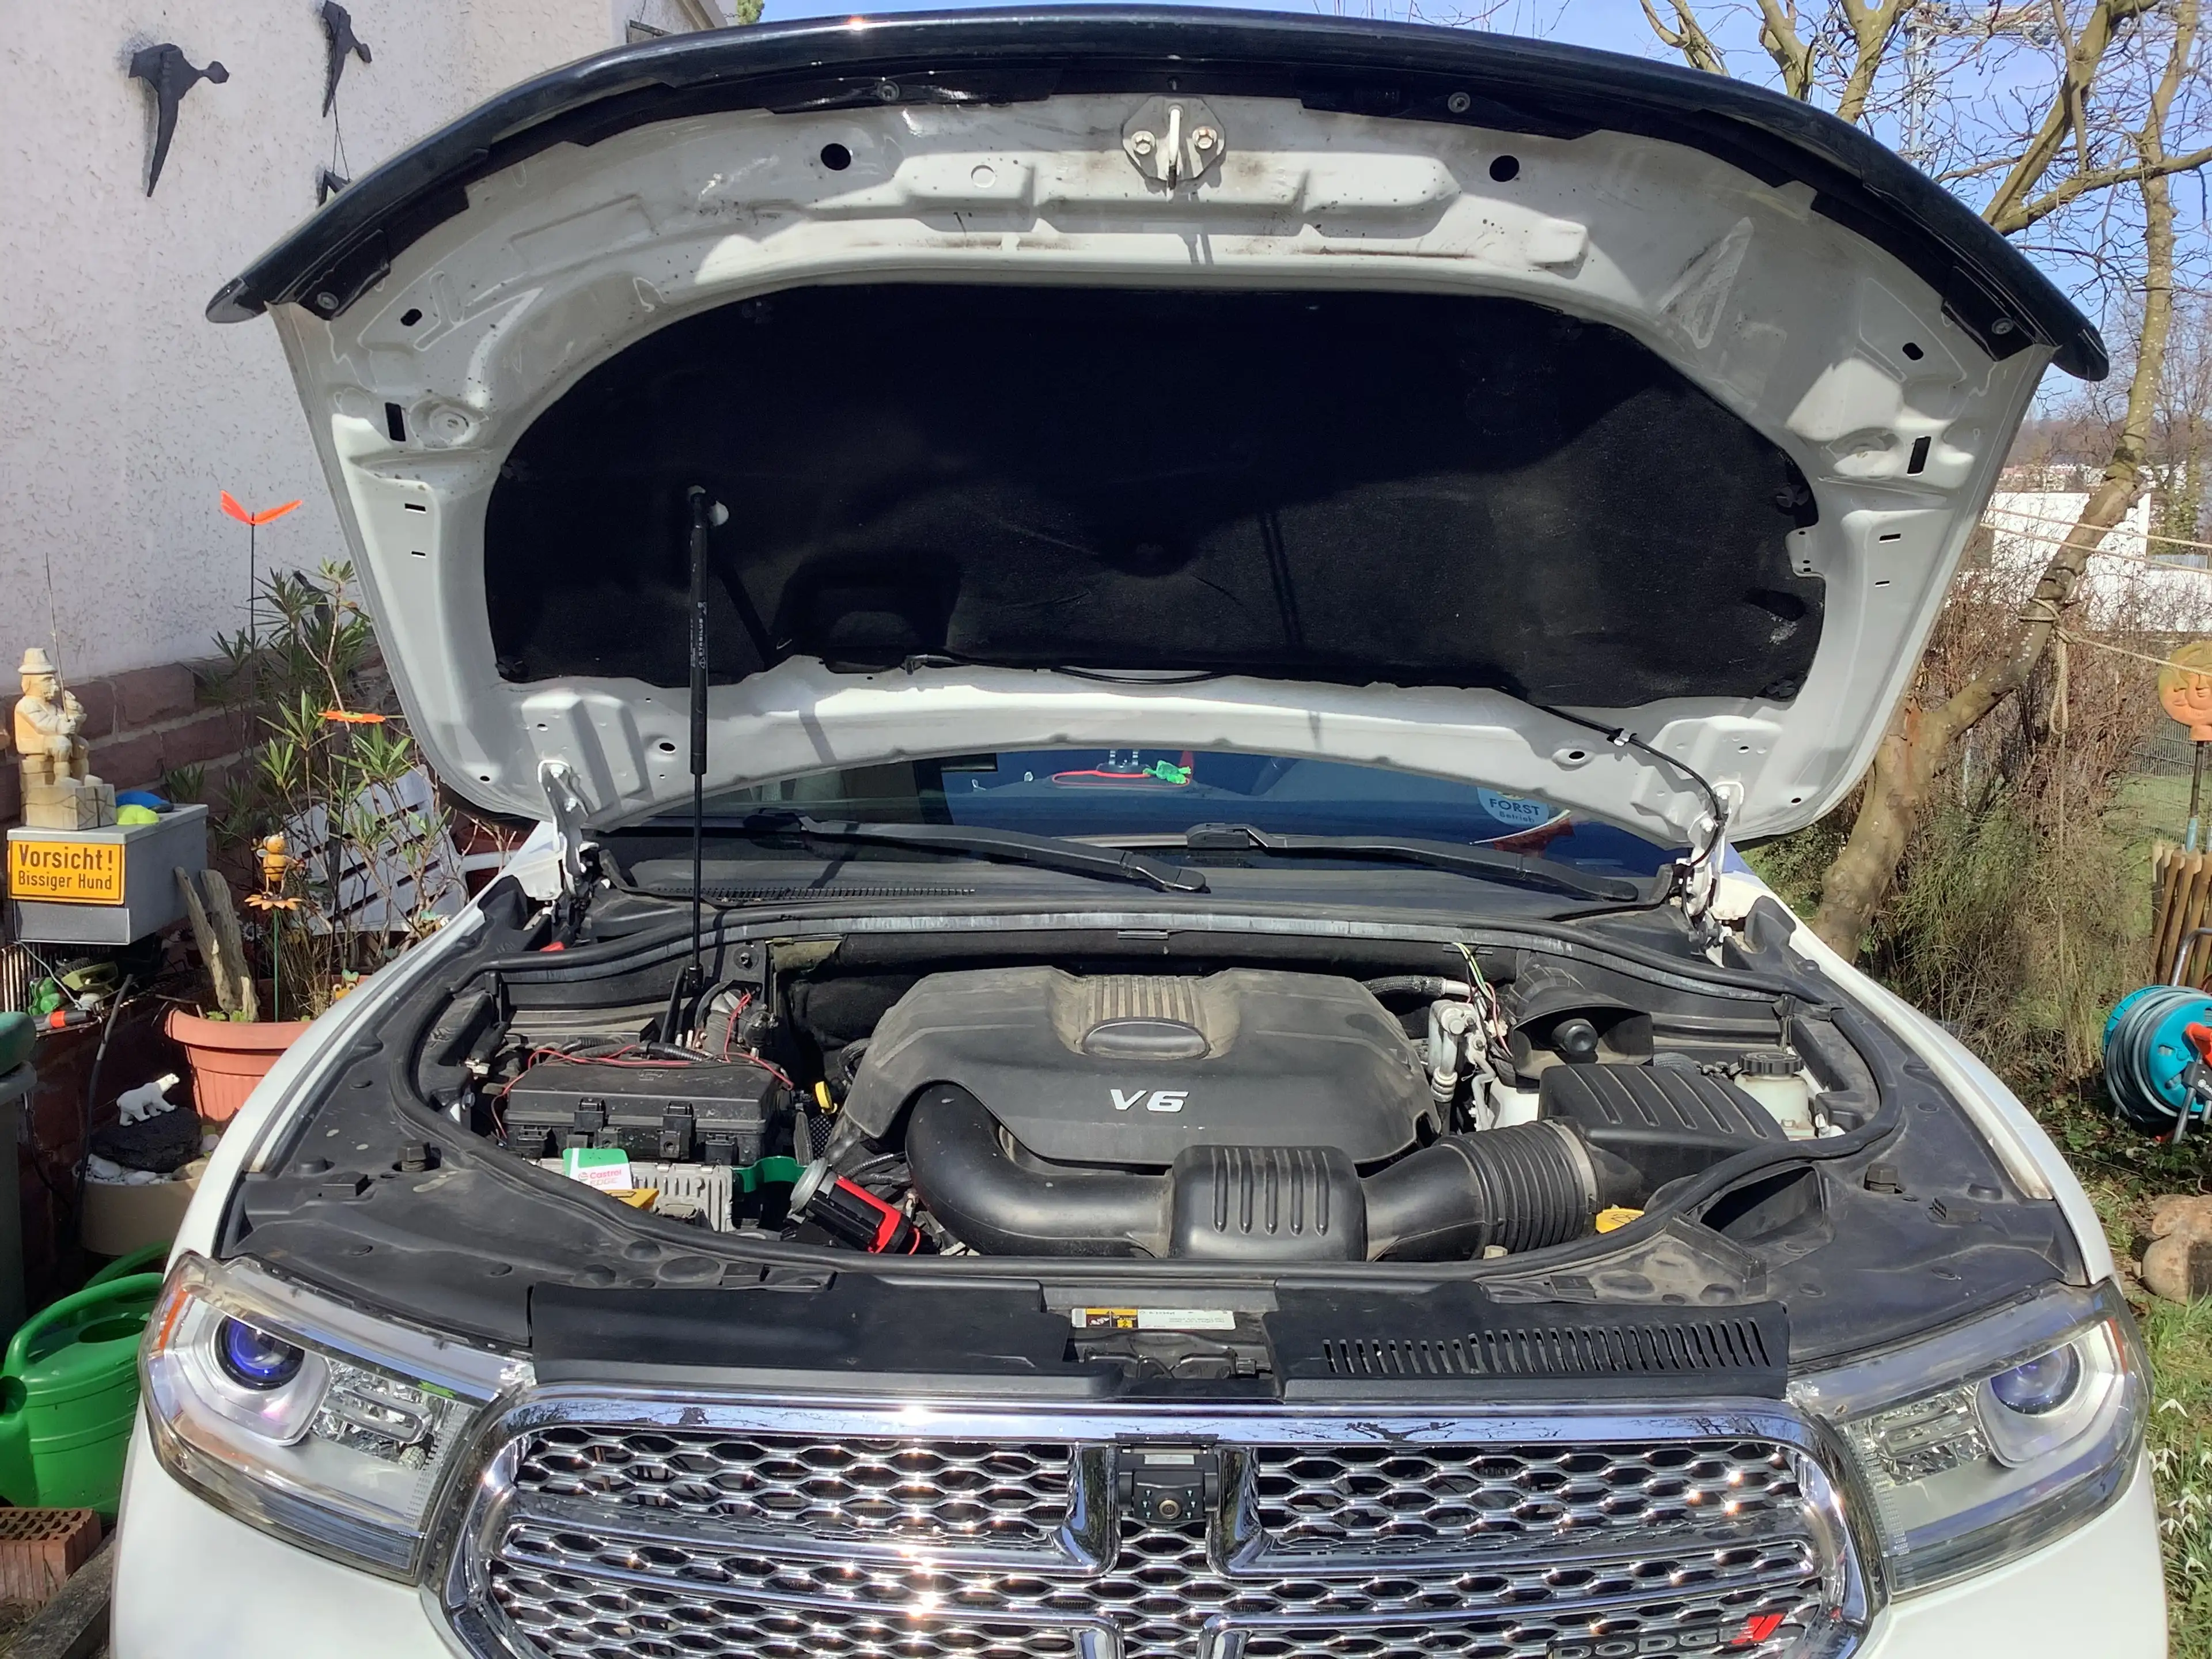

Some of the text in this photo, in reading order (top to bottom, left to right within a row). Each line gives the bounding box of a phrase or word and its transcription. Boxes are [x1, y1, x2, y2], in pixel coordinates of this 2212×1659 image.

[1489, 798, 1540, 816] FORST
[1499, 811, 1535, 823] Betrieb
[19, 844, 112, 871] Vorsicht!
[18, 870, 112, 891] Bissiger Hund
[1110, 1089, 1190, 1112] V6
[589, 1177, 618, 1186] EDGE
[590, 1169, 622, 1179] Castrol
